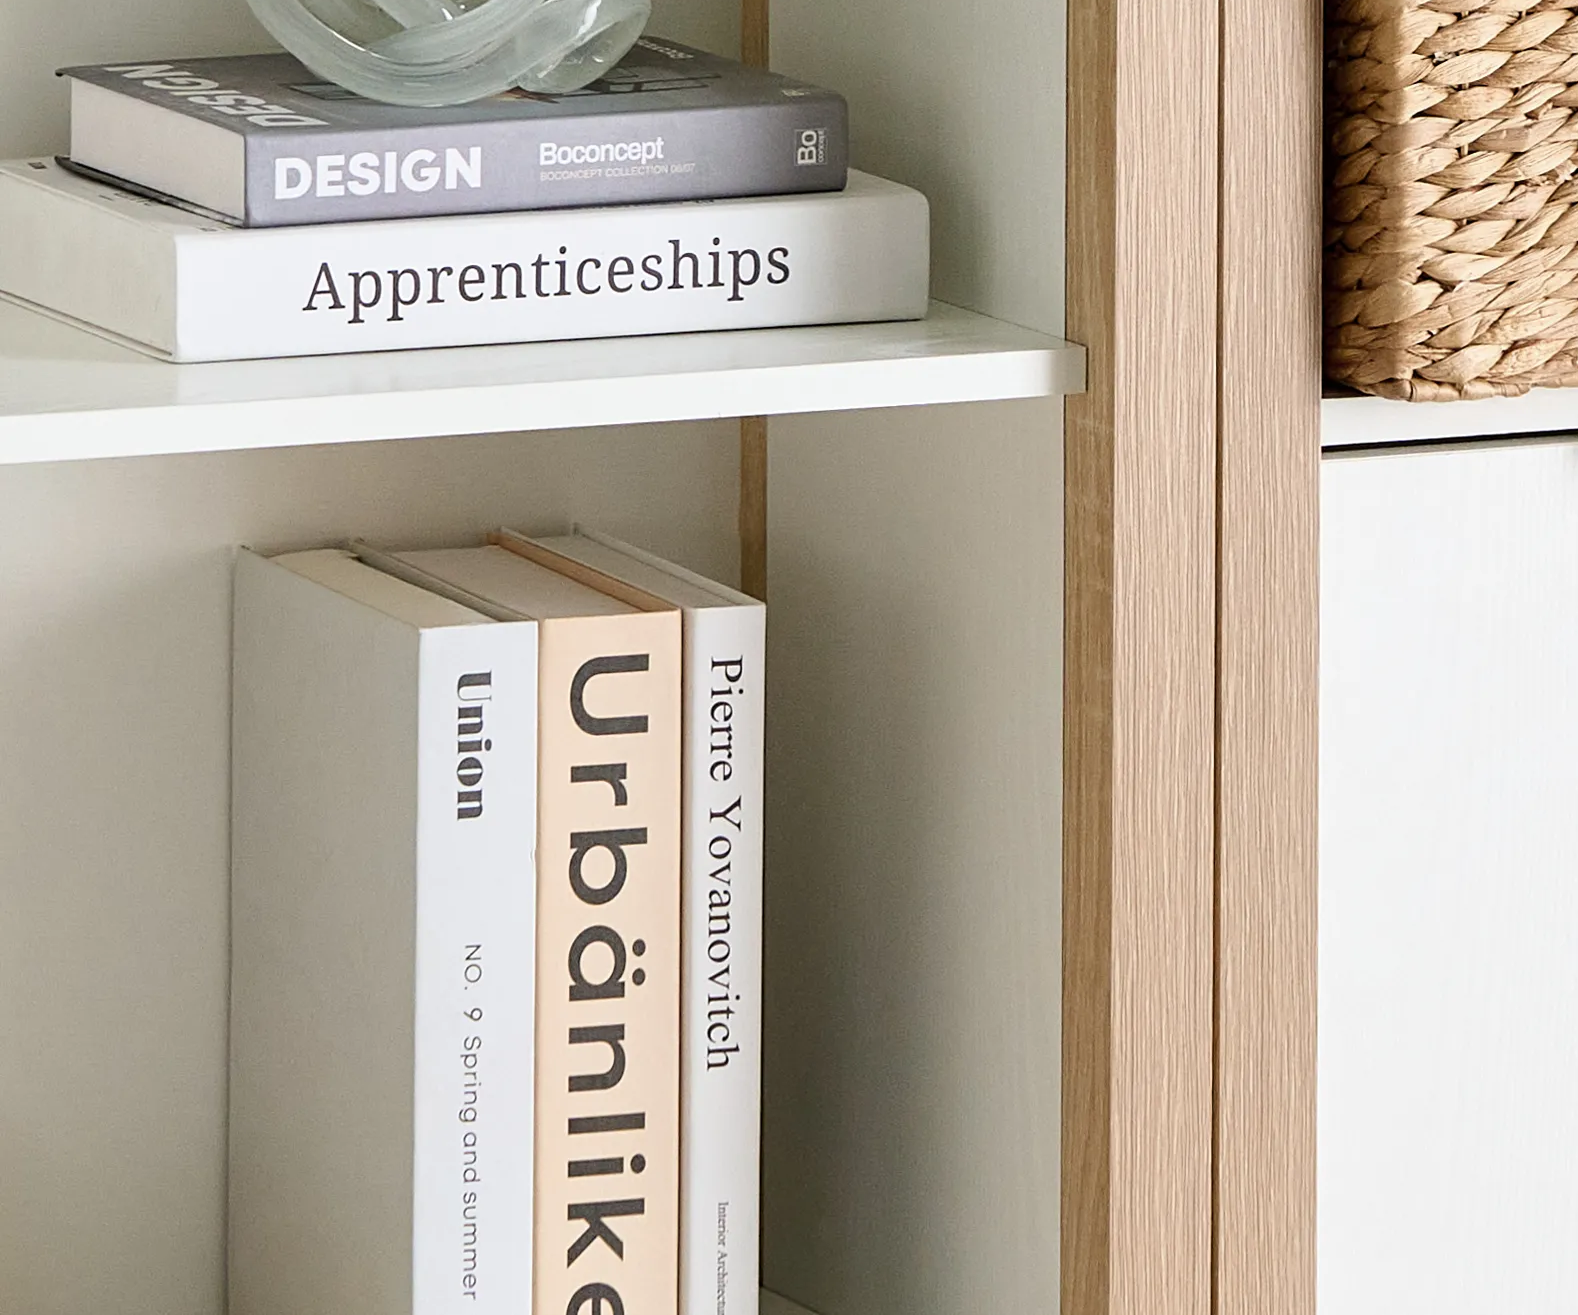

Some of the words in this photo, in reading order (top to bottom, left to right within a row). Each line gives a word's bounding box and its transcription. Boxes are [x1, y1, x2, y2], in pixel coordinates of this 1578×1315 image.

[102, 64, 330, 127] DESIGN
[274, 146, 482, 200] DESIGN
[539, 136, 665, 166] Boconcept
[540, 169, 602, 182] BOCONCEPT
[604, 165, 668, 178] COLLECTION
[797, 130, 818, 164] Bo
[301, 236, 792, 324] Apprenticeships
[456, 670, 493, 821] Union
[709, 655, 744, 782] Pierre
[706, 795, 742, 1071] Yovanovitch
[464, 944, 483, 991] NO.
[463, 1007, 483, 1022] 9
[458, 1035, 482, 1123] Spring
[462, 1131, 482, 1184] and
[462, 1191, 477, 1301] summer
[717, 1201, 729, 1247] Interior
